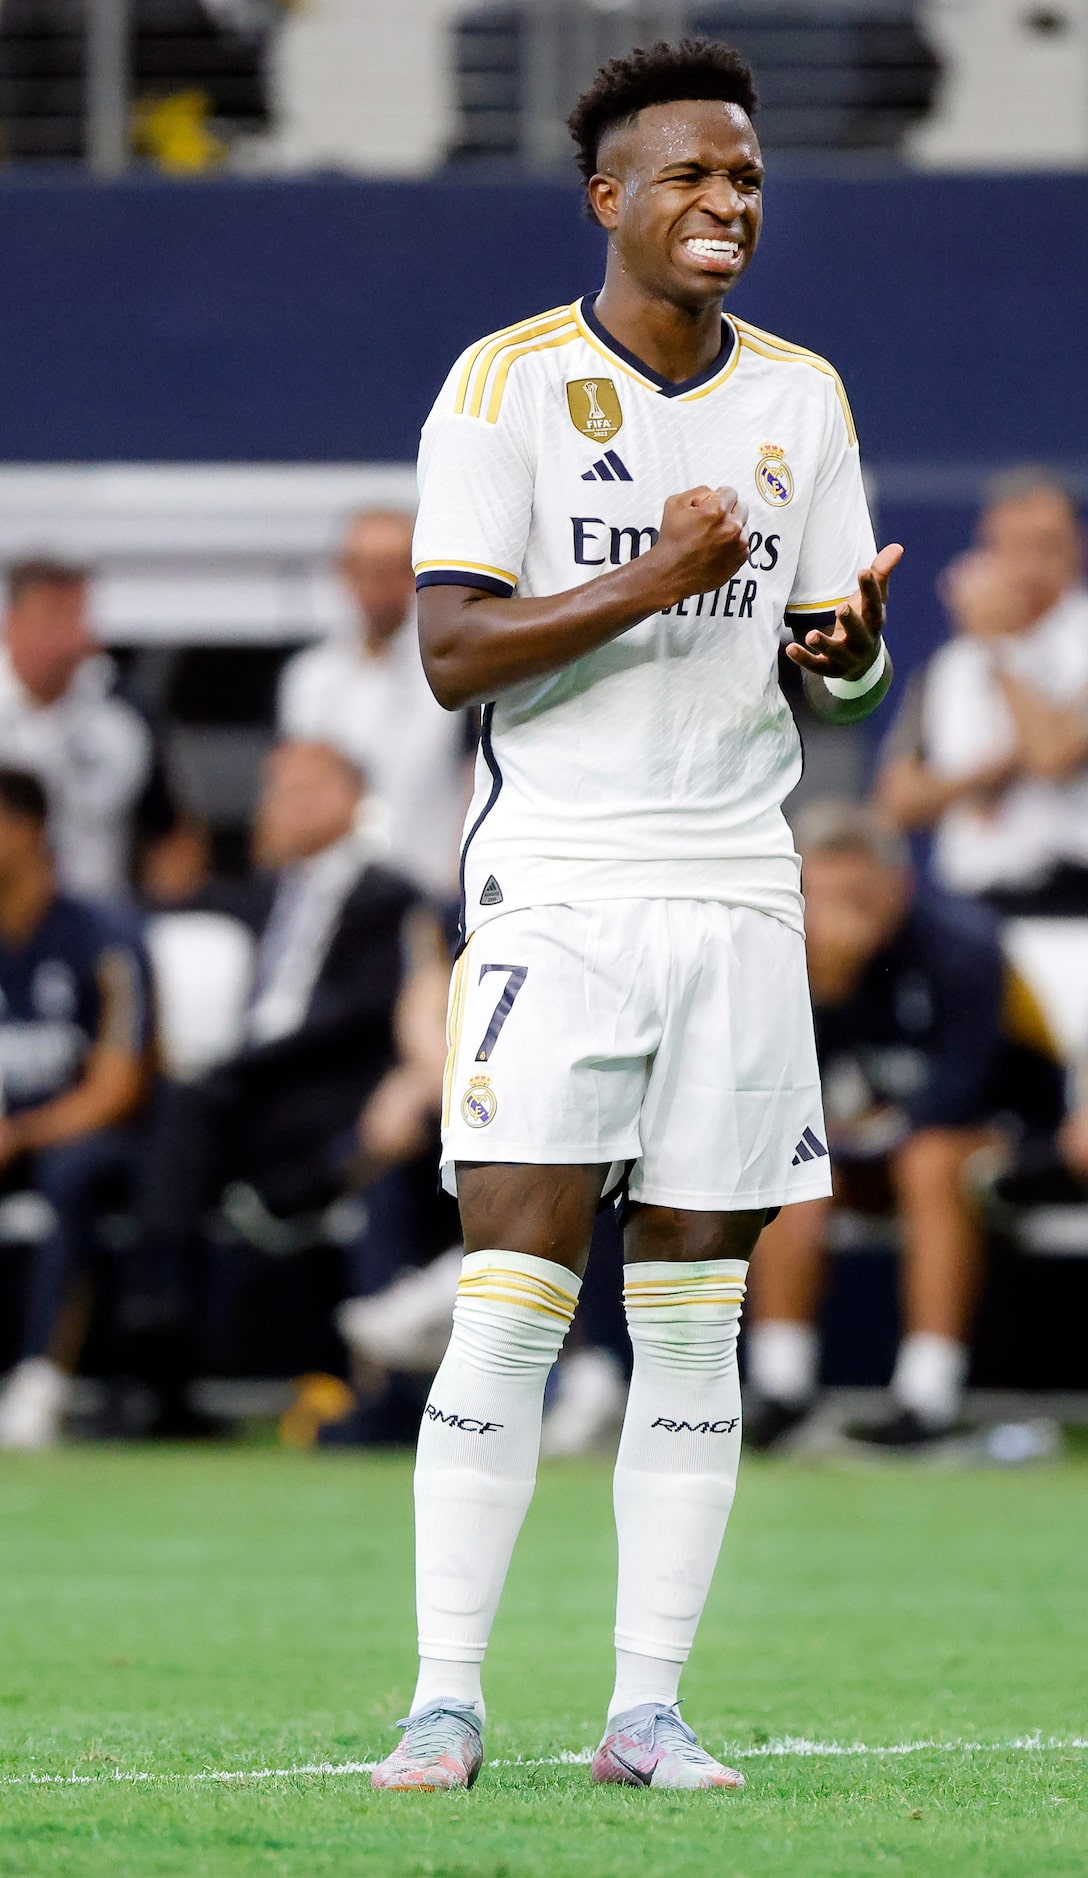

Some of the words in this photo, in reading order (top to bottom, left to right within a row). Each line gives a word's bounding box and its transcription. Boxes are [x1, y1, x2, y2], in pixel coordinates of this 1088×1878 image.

[586, 419, 612, 428] FIFA
[570, 517, 780, 571] Emes
[661, 579, 757, 618] ETTER
[475, 963, 529, 1062] 7
[425, 1403, 504, 1434] RMCF
[651, 1416, 740, 1433] RMCF
